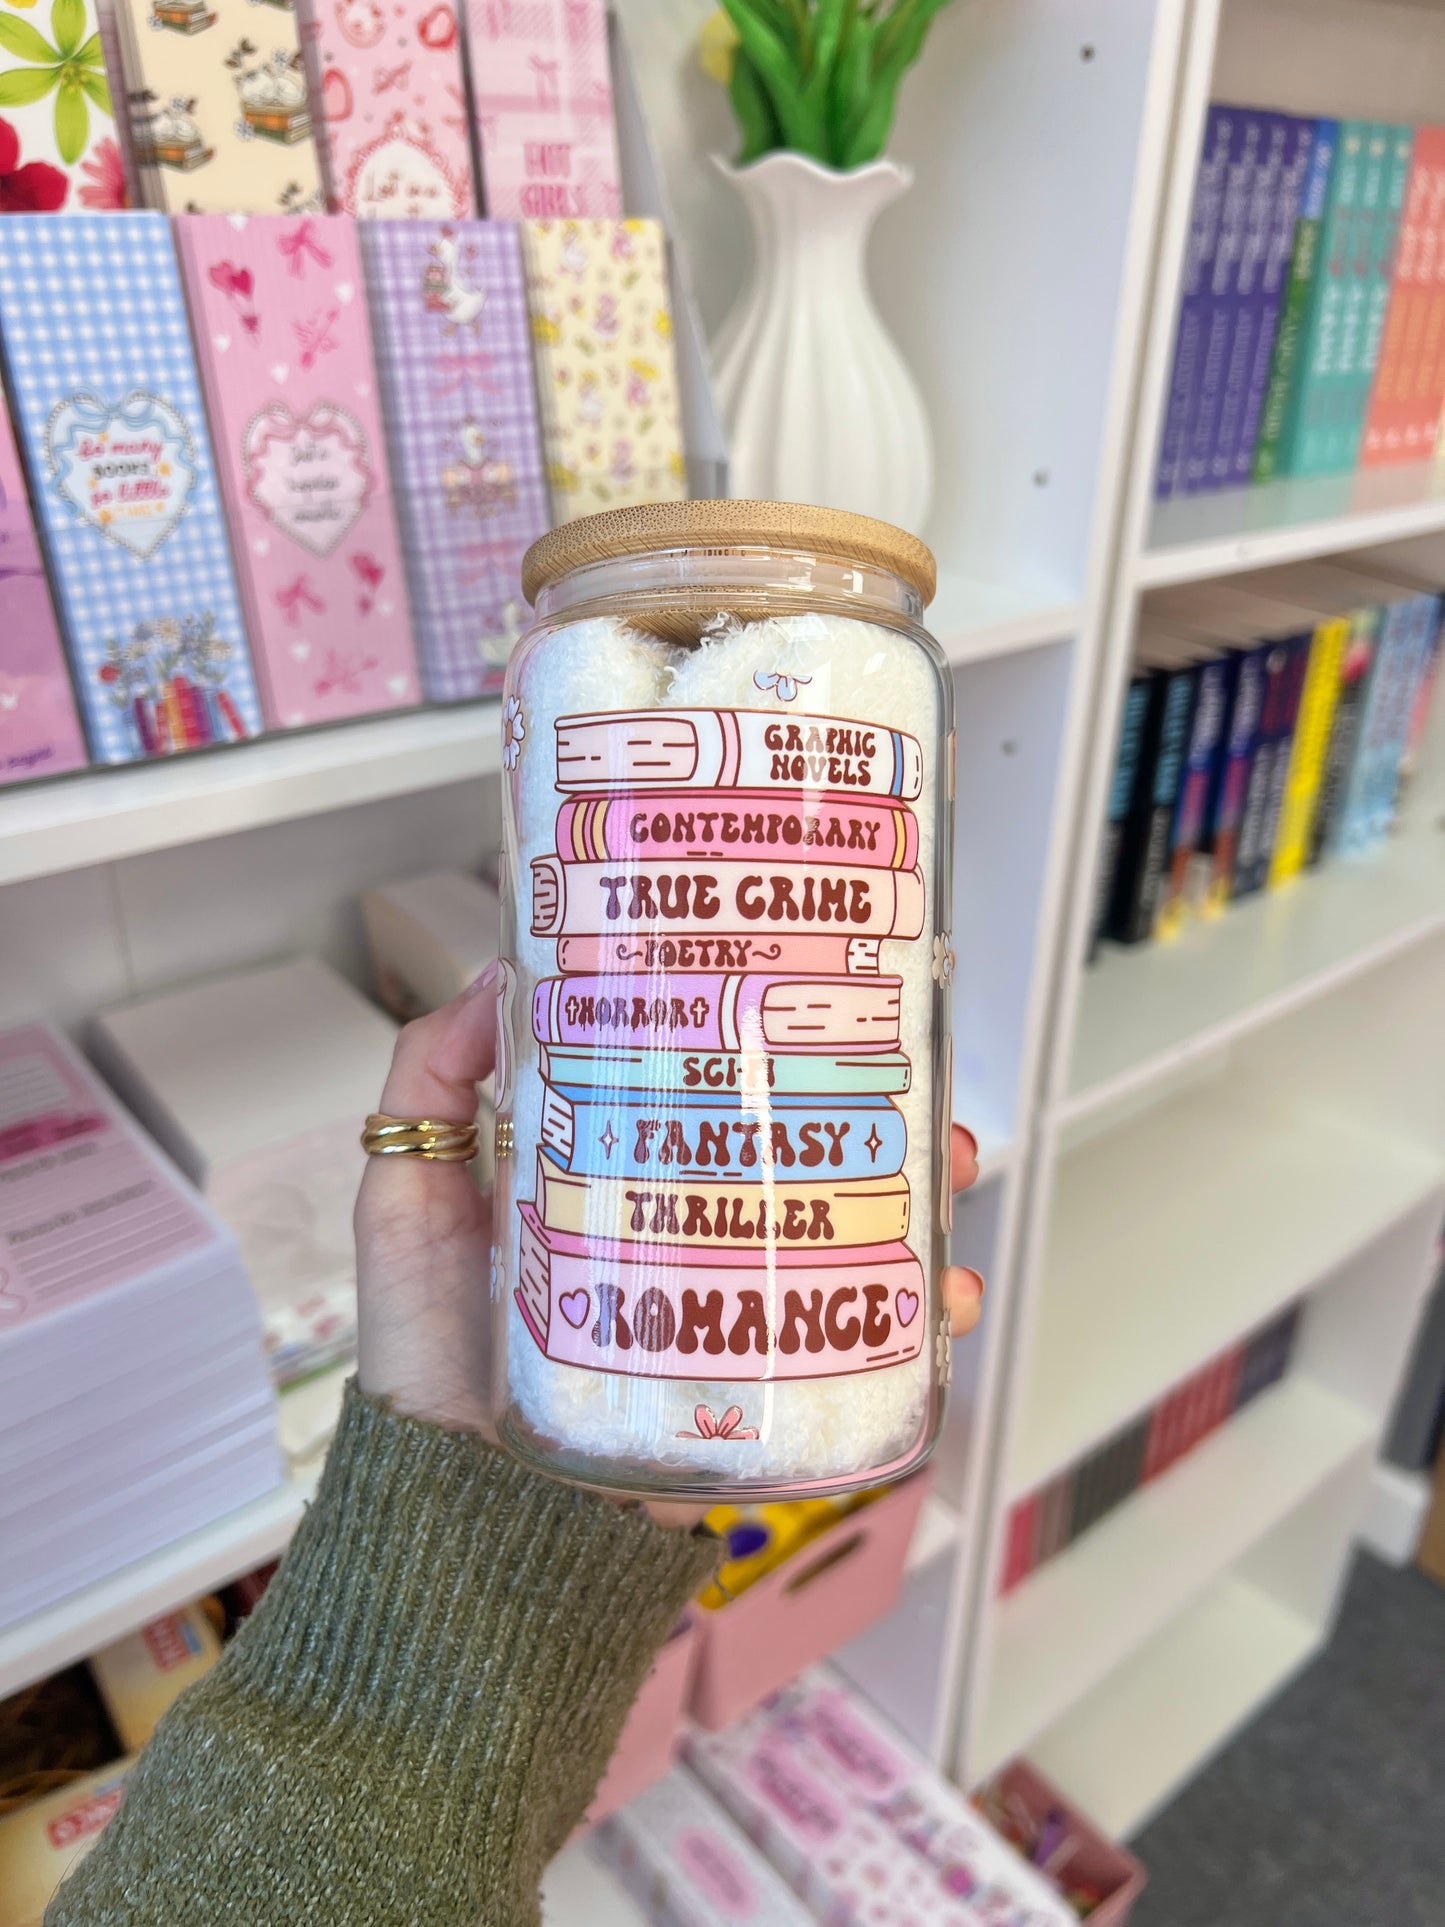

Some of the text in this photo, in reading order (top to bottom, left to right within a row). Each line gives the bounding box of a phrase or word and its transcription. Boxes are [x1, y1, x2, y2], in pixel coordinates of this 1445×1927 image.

[764, 724, 876, 757] GRAPHIC
[771, 754, 872, 786] NOVELS
[629, 812, 881, 850] CONTEMPORARY
[600, 874, 872, 923] TRUE CRIME
[644, 939, 753, 967] POETRY
[578, 996, 689, 1032] HORROR
[633, 1119, 850, 1167] FANTASY
[625, 1190, 835, 1240] THRILLER
[591, 1283, 891, 1355] ROMANCE
